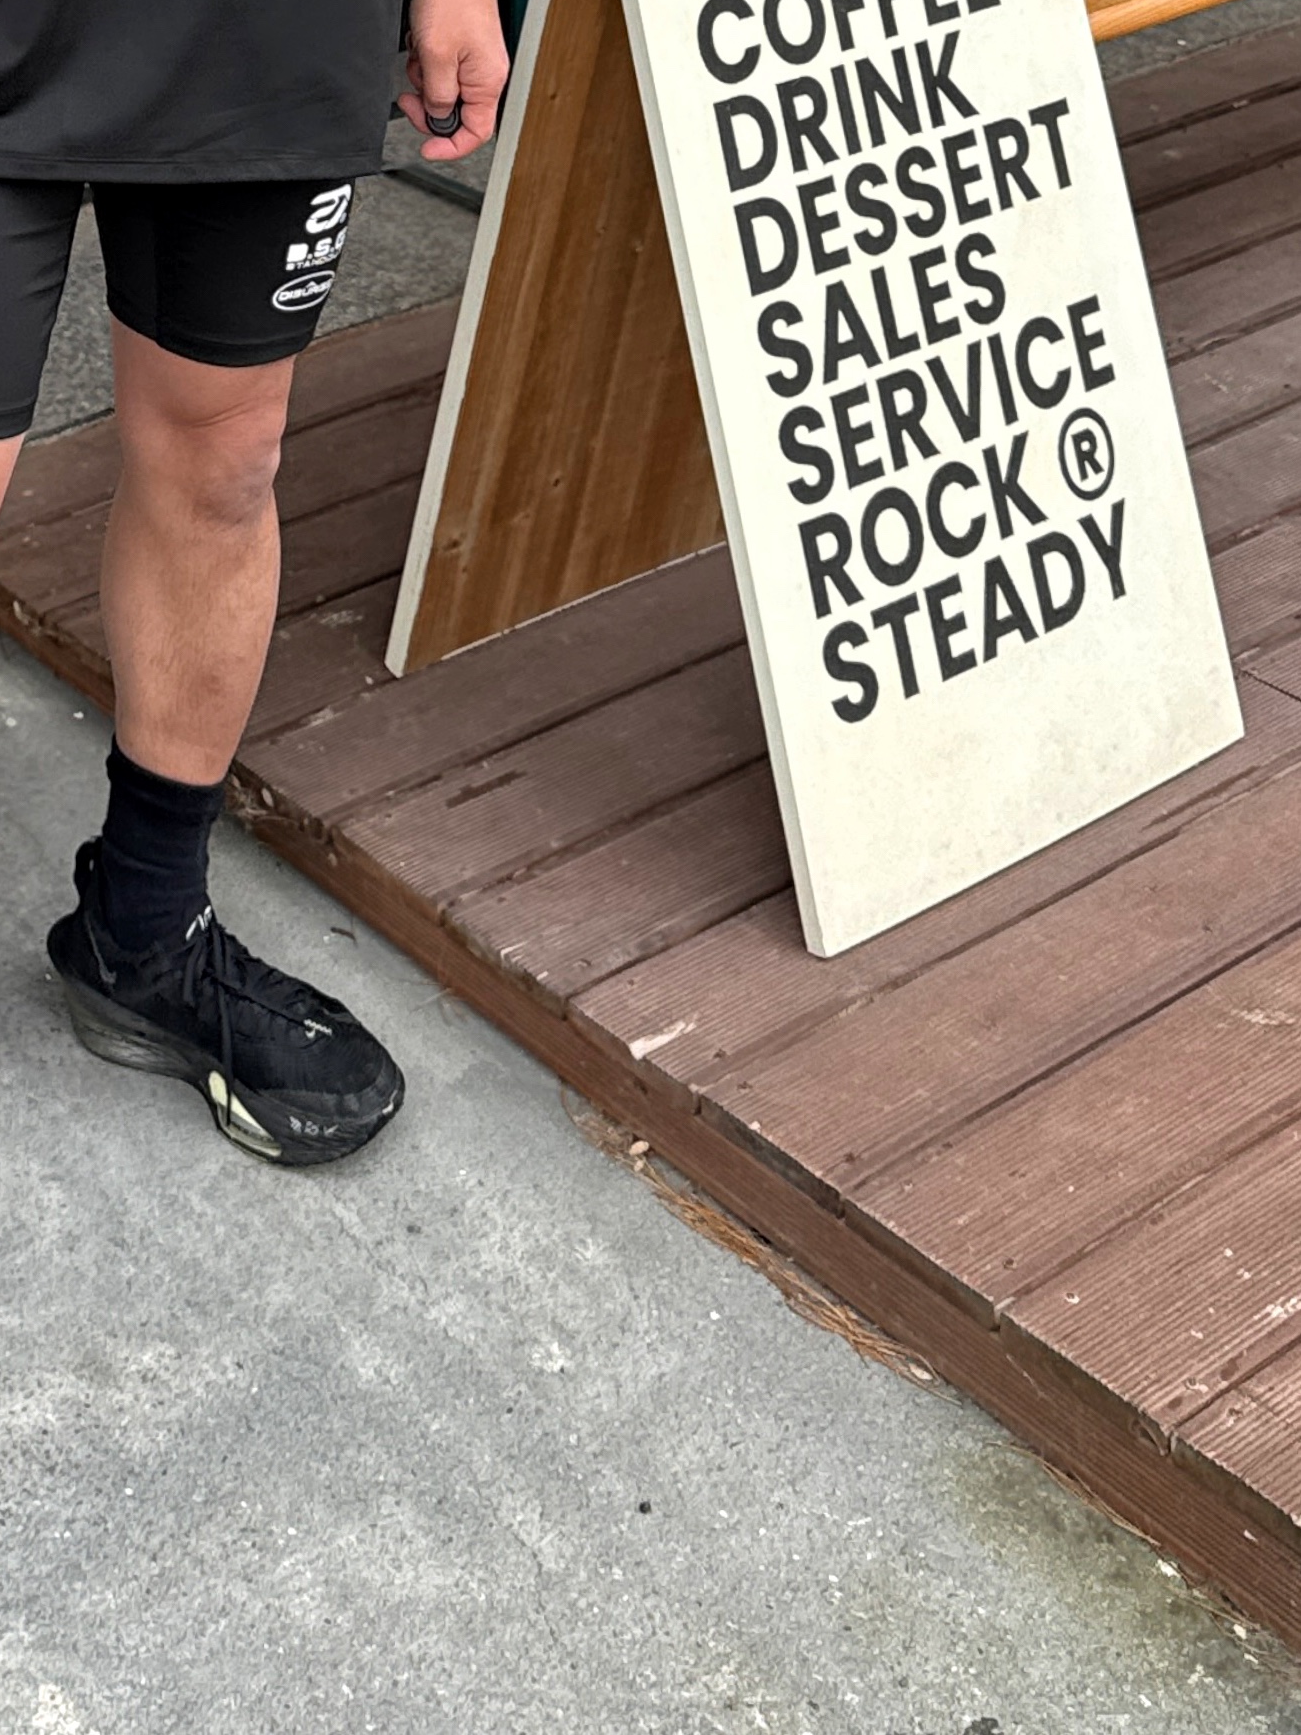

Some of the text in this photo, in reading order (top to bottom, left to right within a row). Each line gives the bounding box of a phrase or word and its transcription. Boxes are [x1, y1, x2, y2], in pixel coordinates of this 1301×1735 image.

[714, 31, 979, 192] DRINK
[734, 99, 1071, 296] DESSERT
[758, 233, 1005, 397] SALES
[779, 296, 1115, 504] SERVICE
[799, 432, 1047, 618] ROCK
[823, 499, 1125, 723] STEADY
